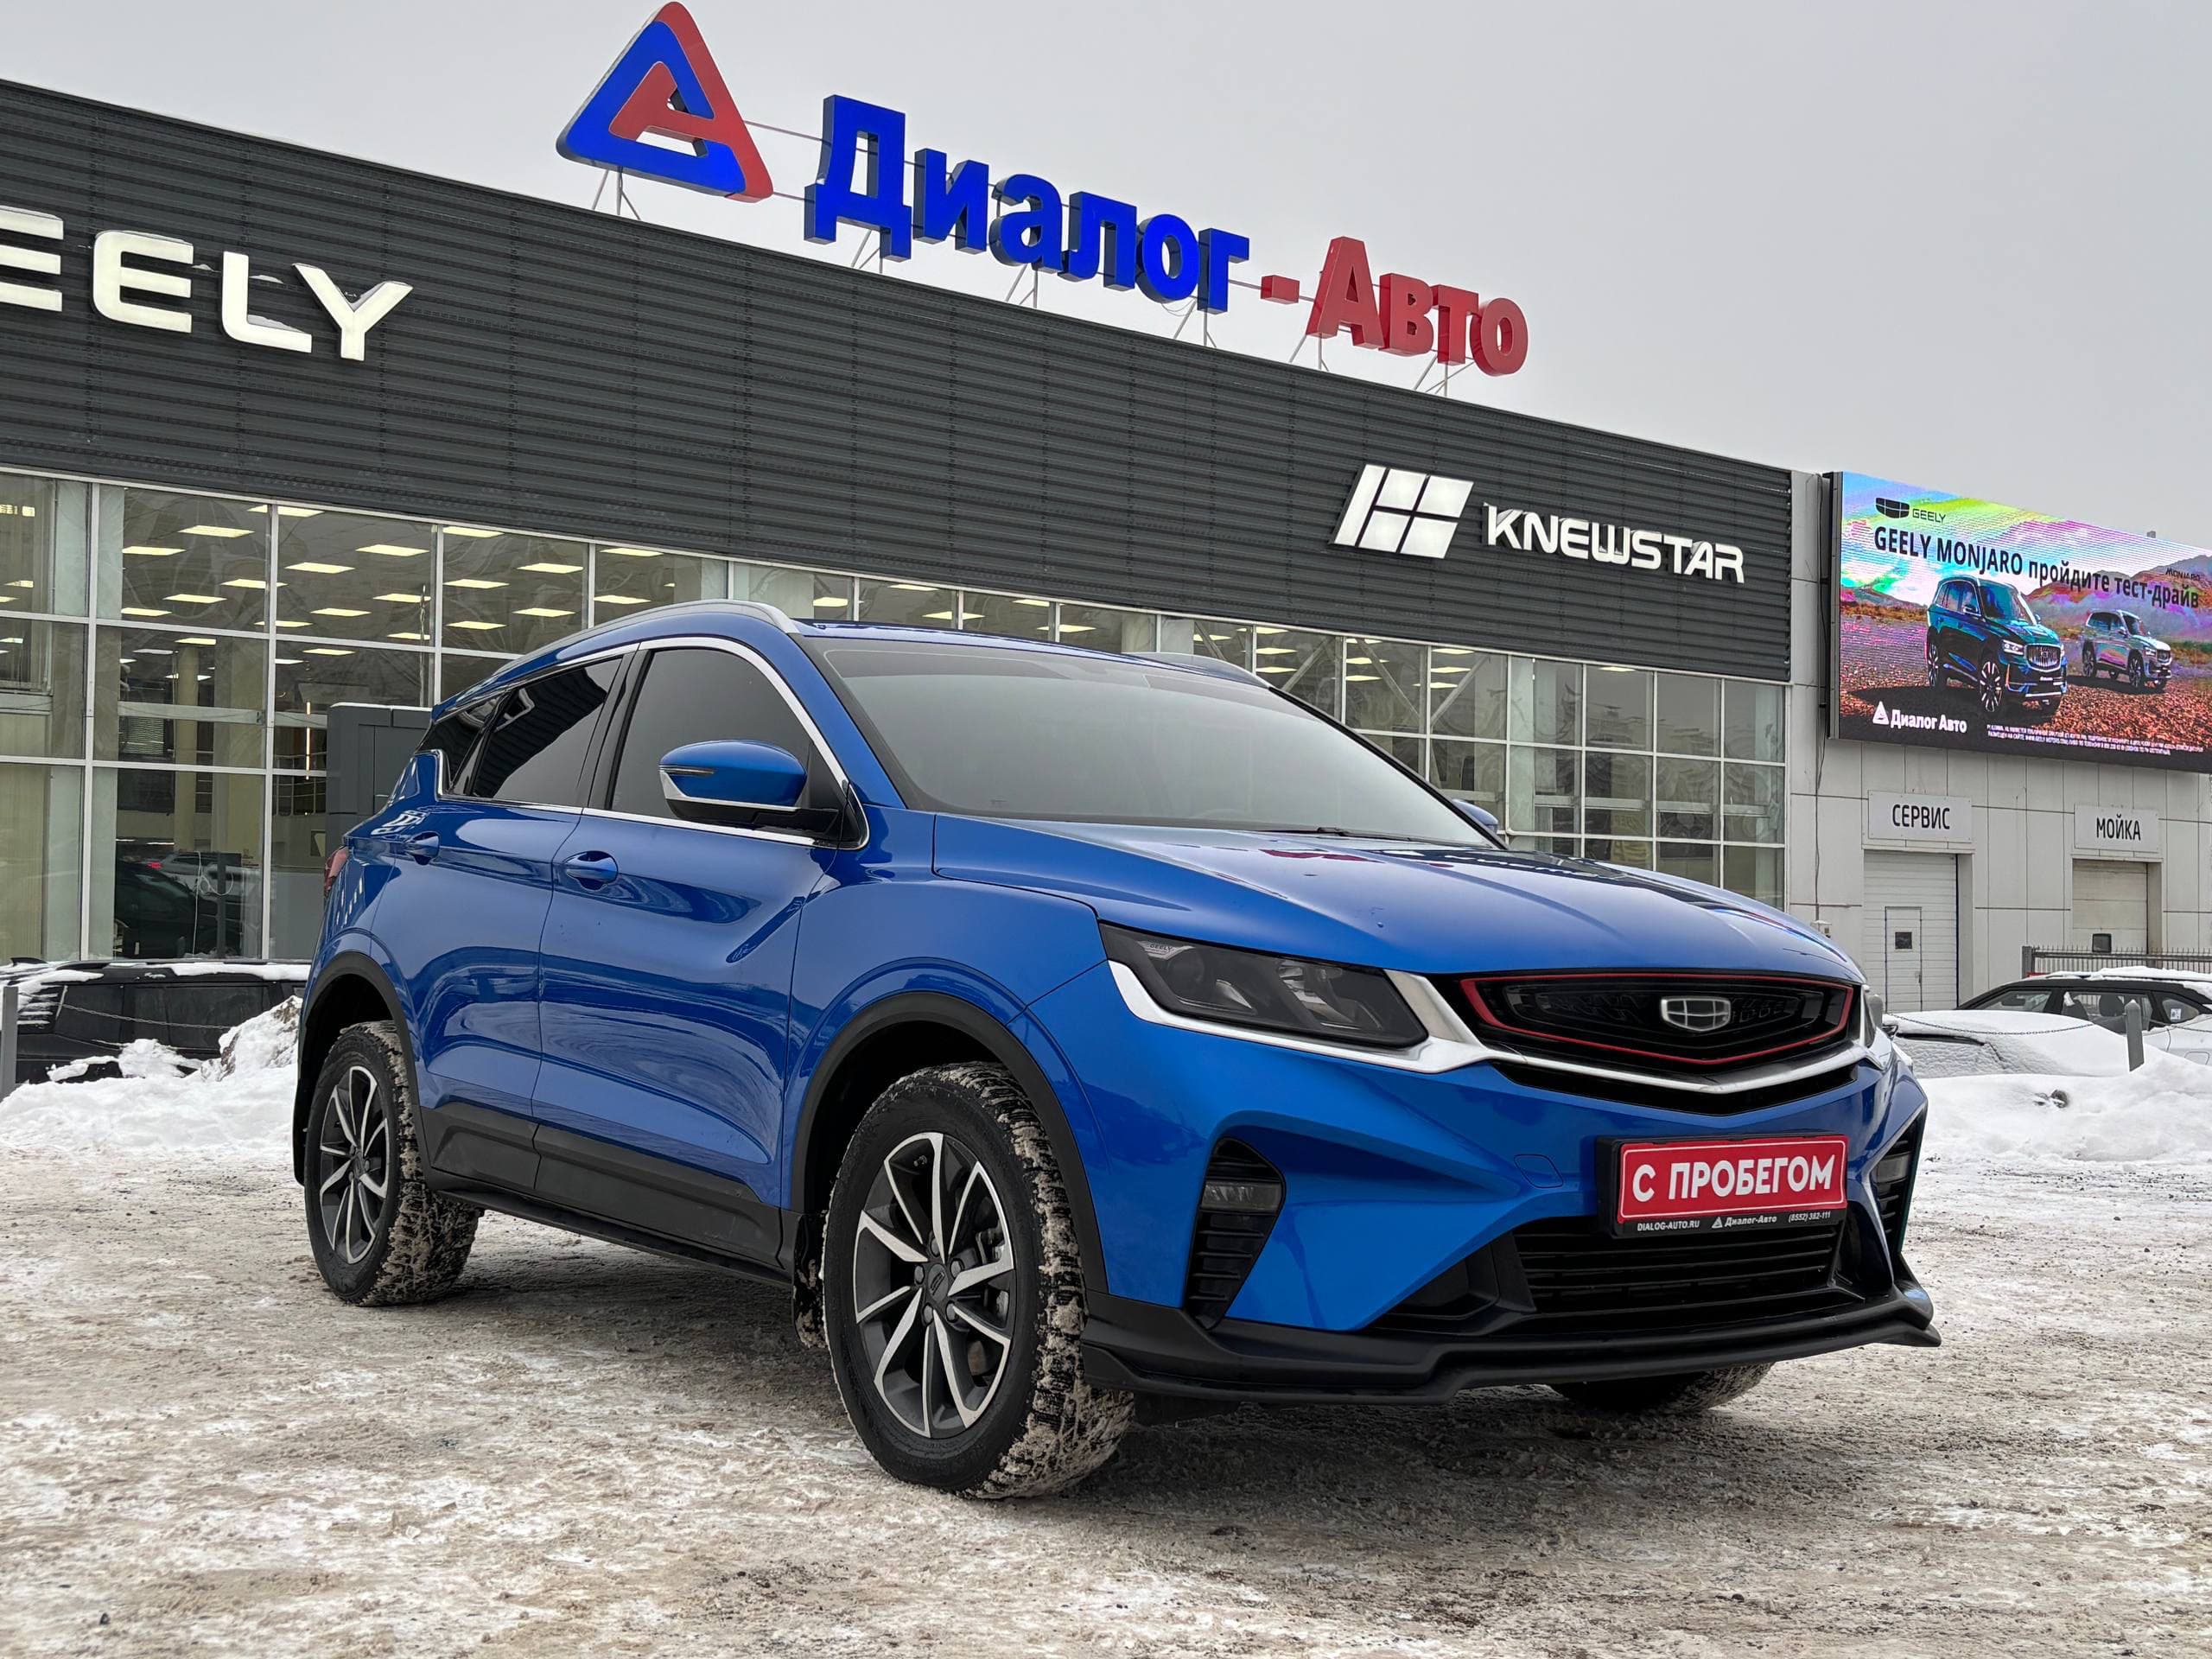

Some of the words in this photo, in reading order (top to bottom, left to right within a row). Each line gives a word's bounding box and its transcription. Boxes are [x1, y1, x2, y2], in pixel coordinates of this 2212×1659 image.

[1912, 508, 1947, 524] GEELY
[1482, 502, 1745, 584] KNEWSTAR
[1874, 526, 1932, 559] GEELY
[1936, 537, 2023, 575] MONJARO
[2029, 560, 2110, 593] пройдите
[2114, 576, 2200, 609] тест-драйв
[1891, 709, 1937, 729] Диалог
[1938, 715, 1967, 734] Авто
[1891, 804, 1951, 830] СЕРВИС
[2095, 813, 2142, 842] МОЙКА
[1632, 1164, 1656, 1203] С
[1669, 1154, 1836, 1200] ПРОБЕГОМ
[1637, 1219, 1700, 1232] DIALOG-AUTO.RU
[1724, 1214, 1777, 1228] Диалог-Авто
